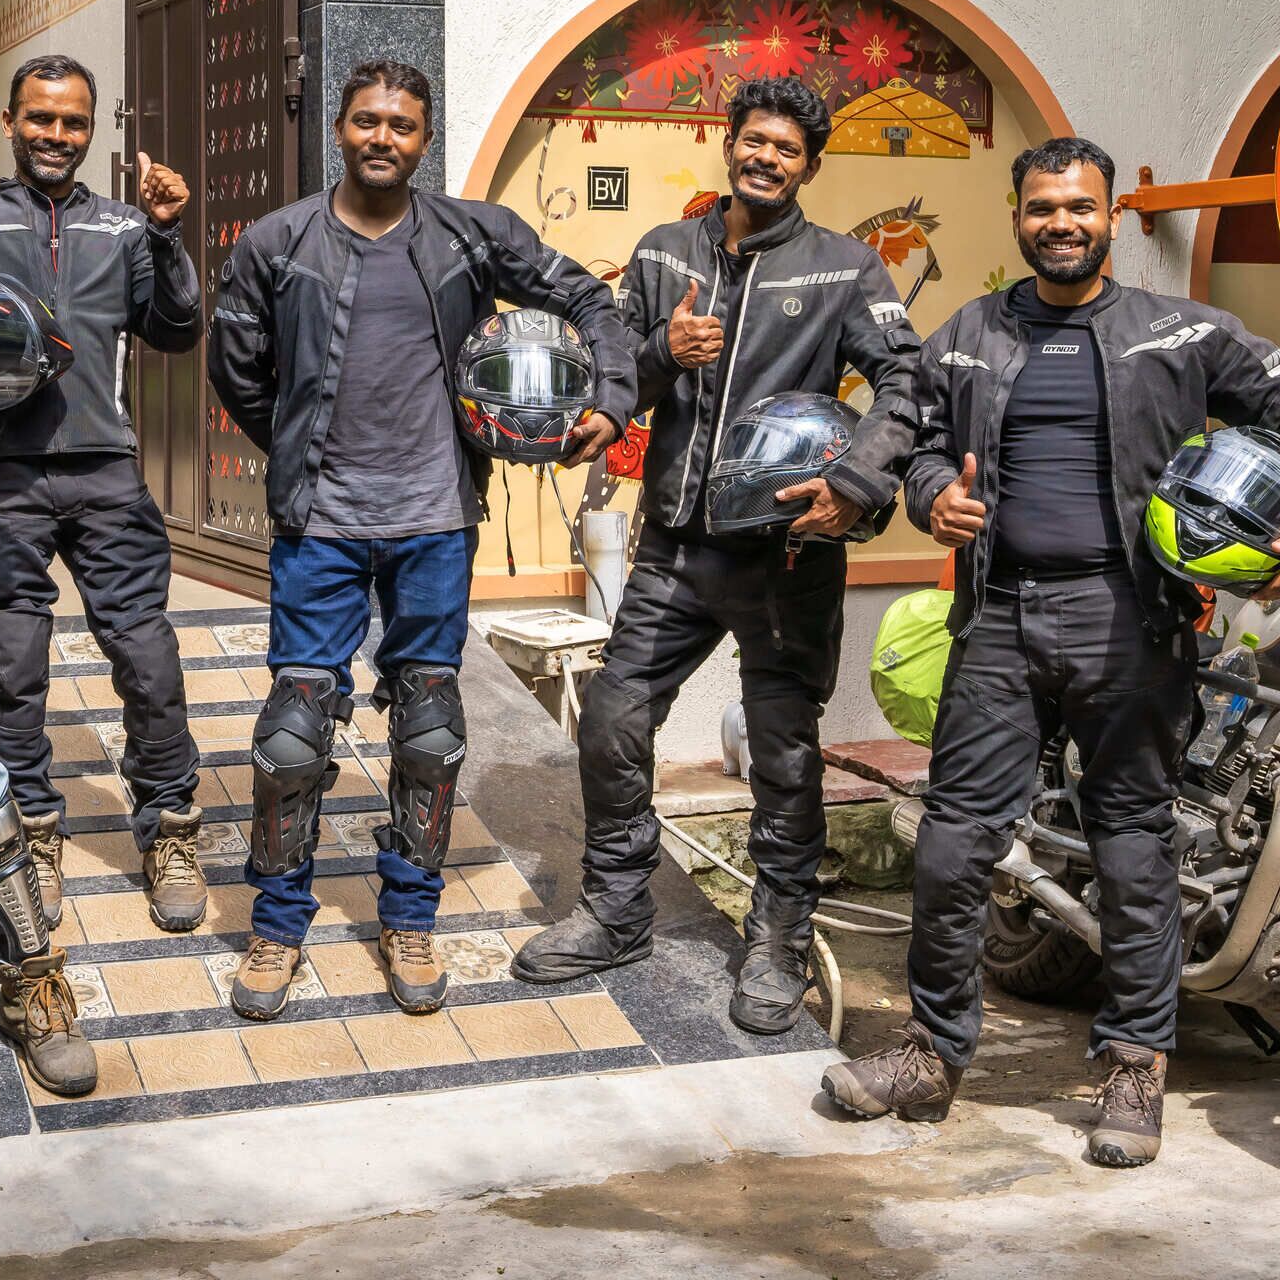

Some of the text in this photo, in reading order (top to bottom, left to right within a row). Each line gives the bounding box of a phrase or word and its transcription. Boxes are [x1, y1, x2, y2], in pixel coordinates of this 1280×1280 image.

[594, 176, 622, 201] BV
[1151, 312, 1181, 331] RYNOX
[1043, 345, 1079, 354] RYNOX
